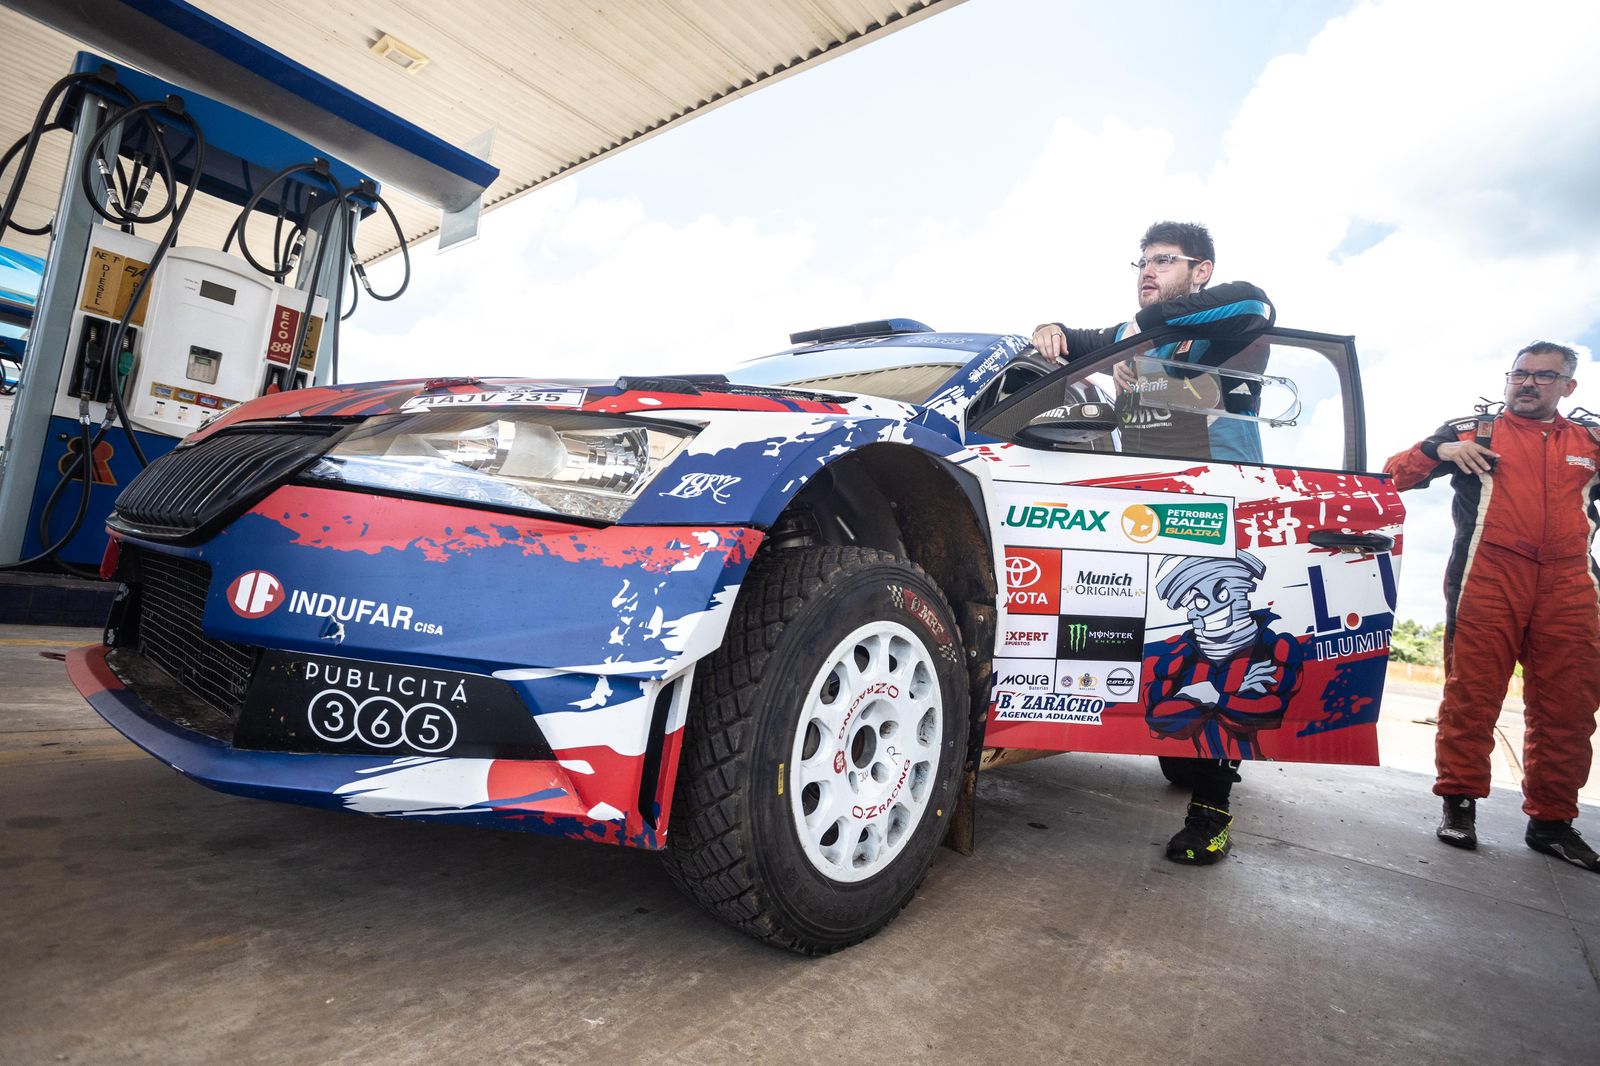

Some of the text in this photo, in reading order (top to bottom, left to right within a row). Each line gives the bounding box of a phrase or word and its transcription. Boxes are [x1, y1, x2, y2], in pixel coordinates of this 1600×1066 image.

[95, 264, 110, 305] DIESEL
[278, 310, 290, 339] ECO
[270, 341, 291, 353] 88
[418, 393, 562, 405] AAJV 235
[1000, 505, 1110, 532] UBRAX
[1167, 508, 1224, 520] PETROBRAS
[1165, 517, 1223, 528] RALLY
[1076, 570, 1133, 586] Munich
[1007, 592, 1048, 605] YOTA
[1075, 585, 1133, 597] ORIGINAL
[288, 589, 414, 630] INDUFAR
[413, 621, 444, 636] CISA
[1088, 630, 1133, 639] MONSTER
[305, 662, 467, 703] PUBLICITÁ
[1021, 695, 1104, 713] ZARACHO
[838, 685, 874, 740] RACING
[1000, 711, 1100, 722] AGENCIA ADUANERA
[323, 700, 441, 744] 365
[878, 759, 911, 814] RACING
